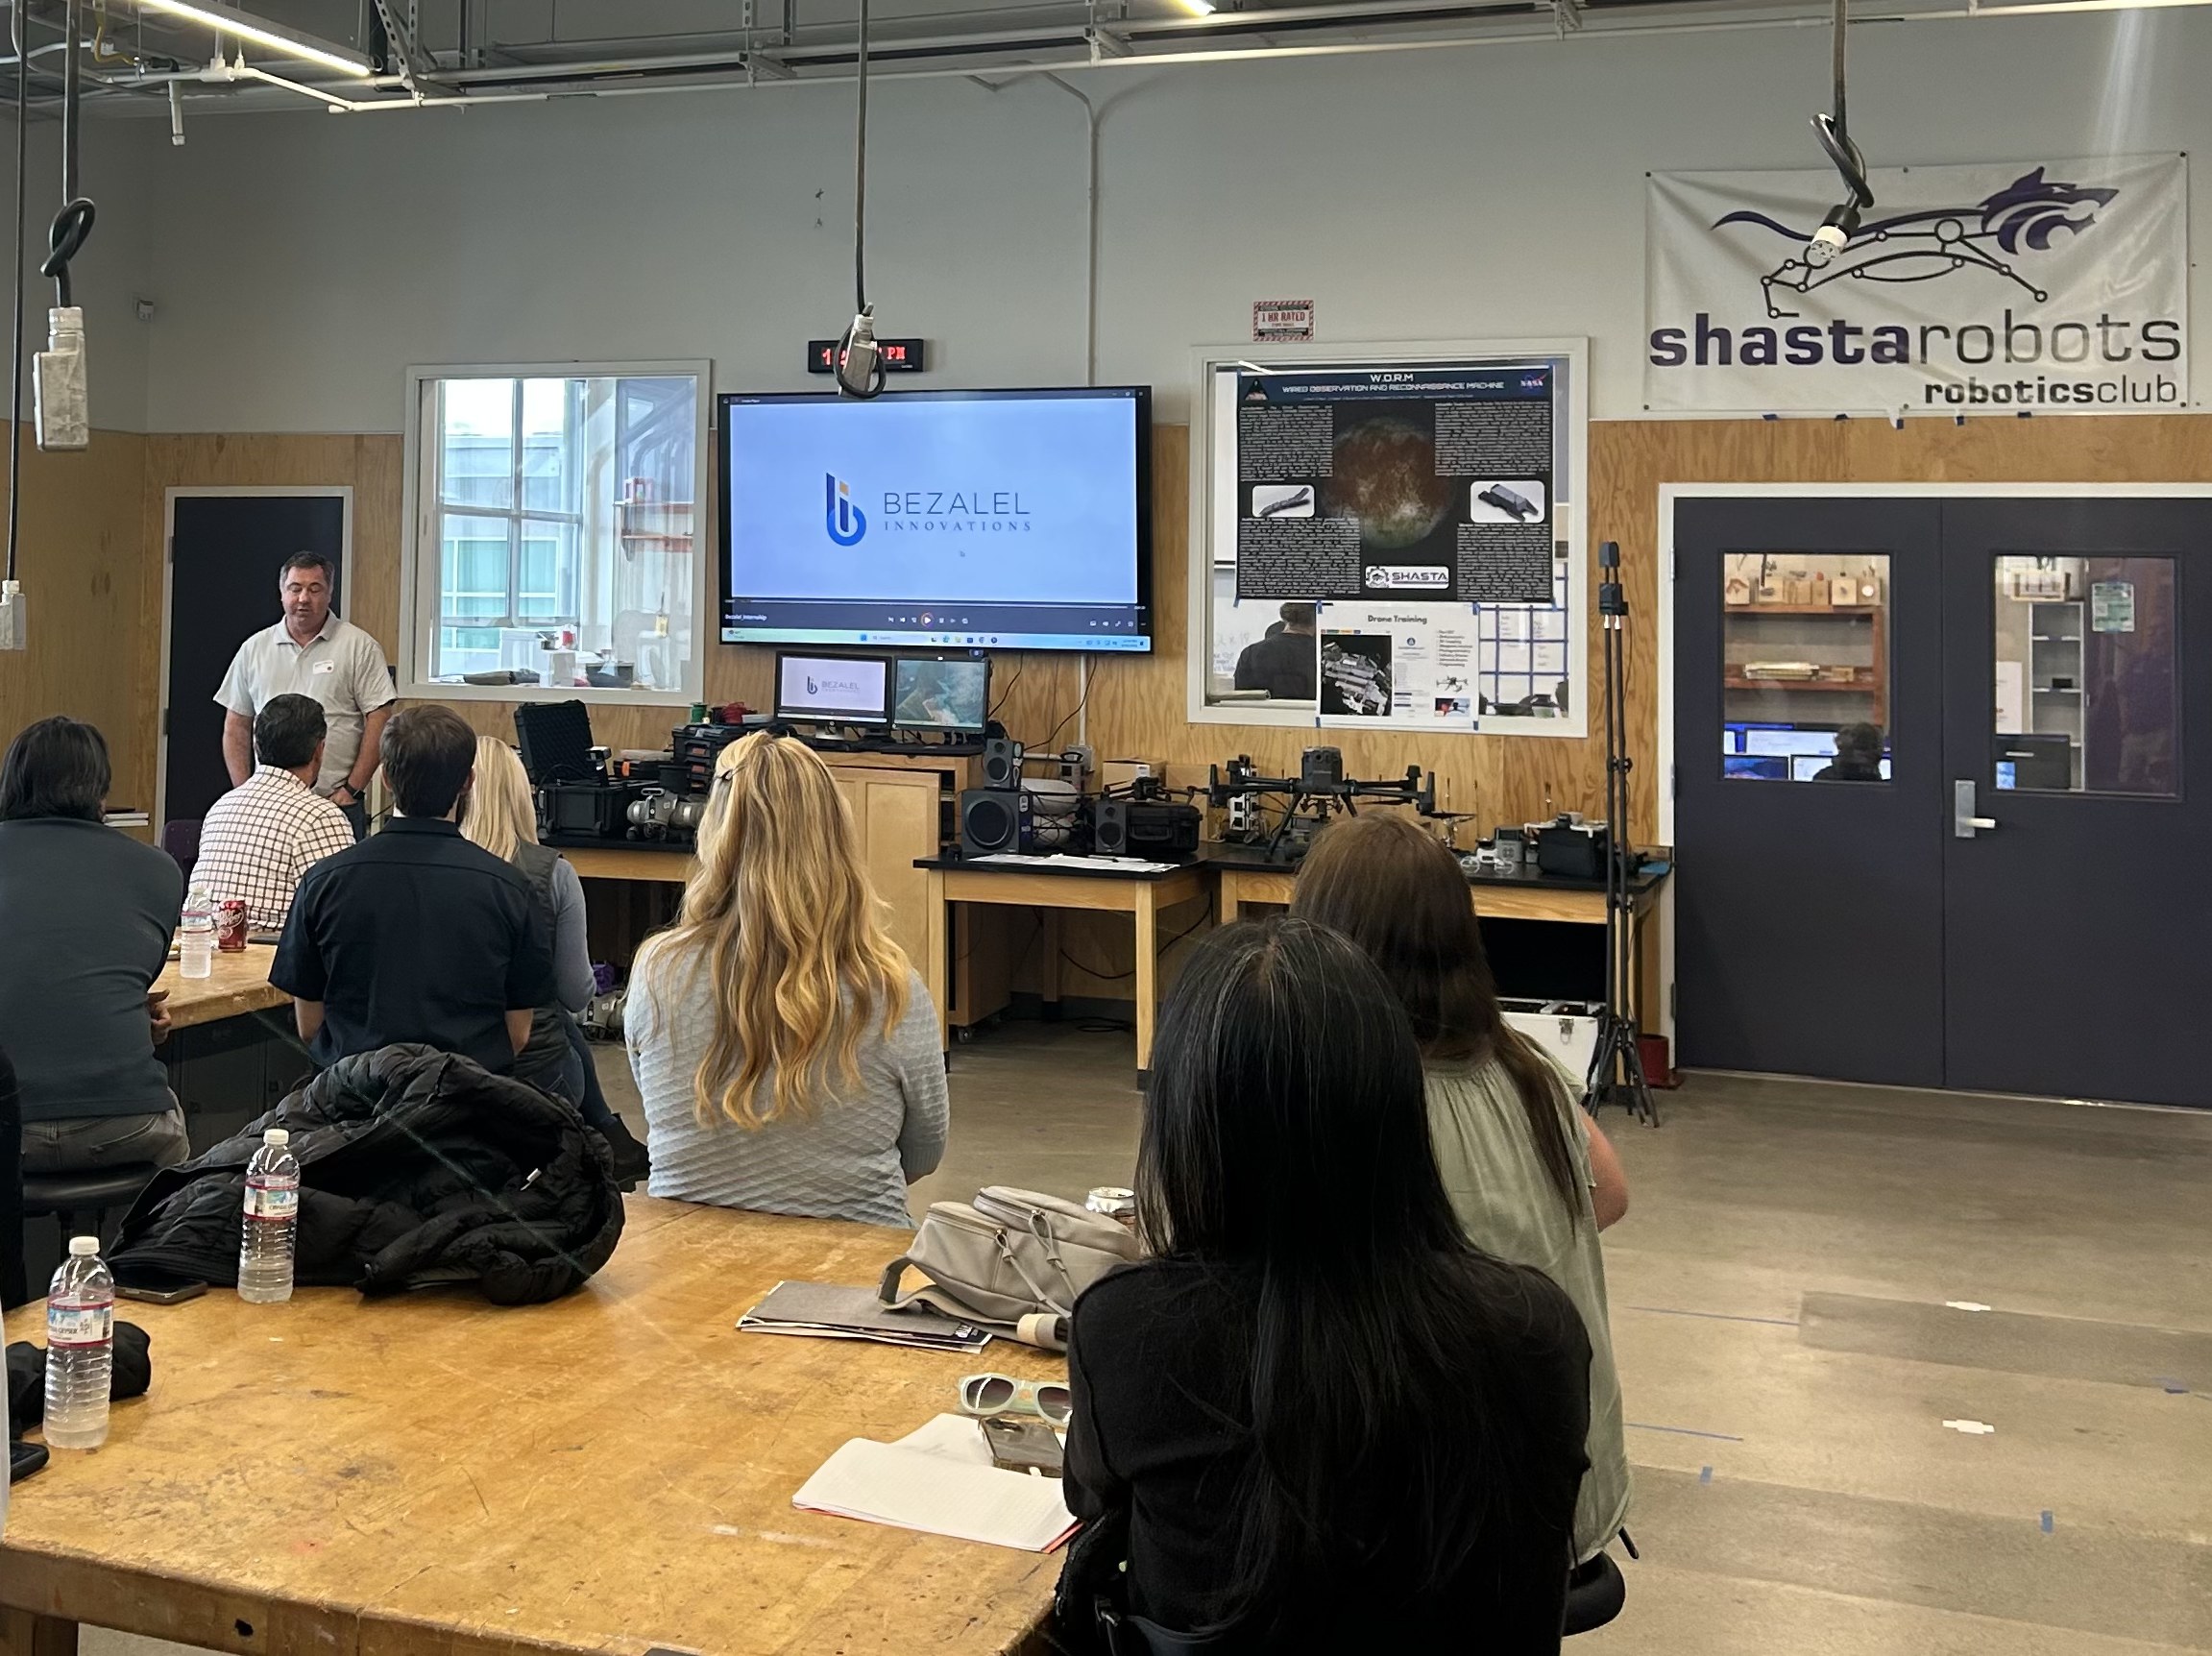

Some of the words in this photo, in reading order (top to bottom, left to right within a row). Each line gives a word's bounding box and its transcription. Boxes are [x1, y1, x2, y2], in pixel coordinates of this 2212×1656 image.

[1268, 312, 1279, 322] HR
[1281, 311, 1305, 322] RATED
[887, 347, 906, 360] PM
[1309, 384, 1369, 393] OBSERVATION
[1924, 375, 2177, 405] roboticsclub
[884, 492, 1031, 515] BEZALEL
[885, 521, 1031, 532] INNOVATIONS
[1392, 572, 1447, 581] SHASTA
[1368, 615, 1392, 623] Drone
[1394, 615, 1428, 624] Training
[821, 681, 861, 690] BEZALEL
